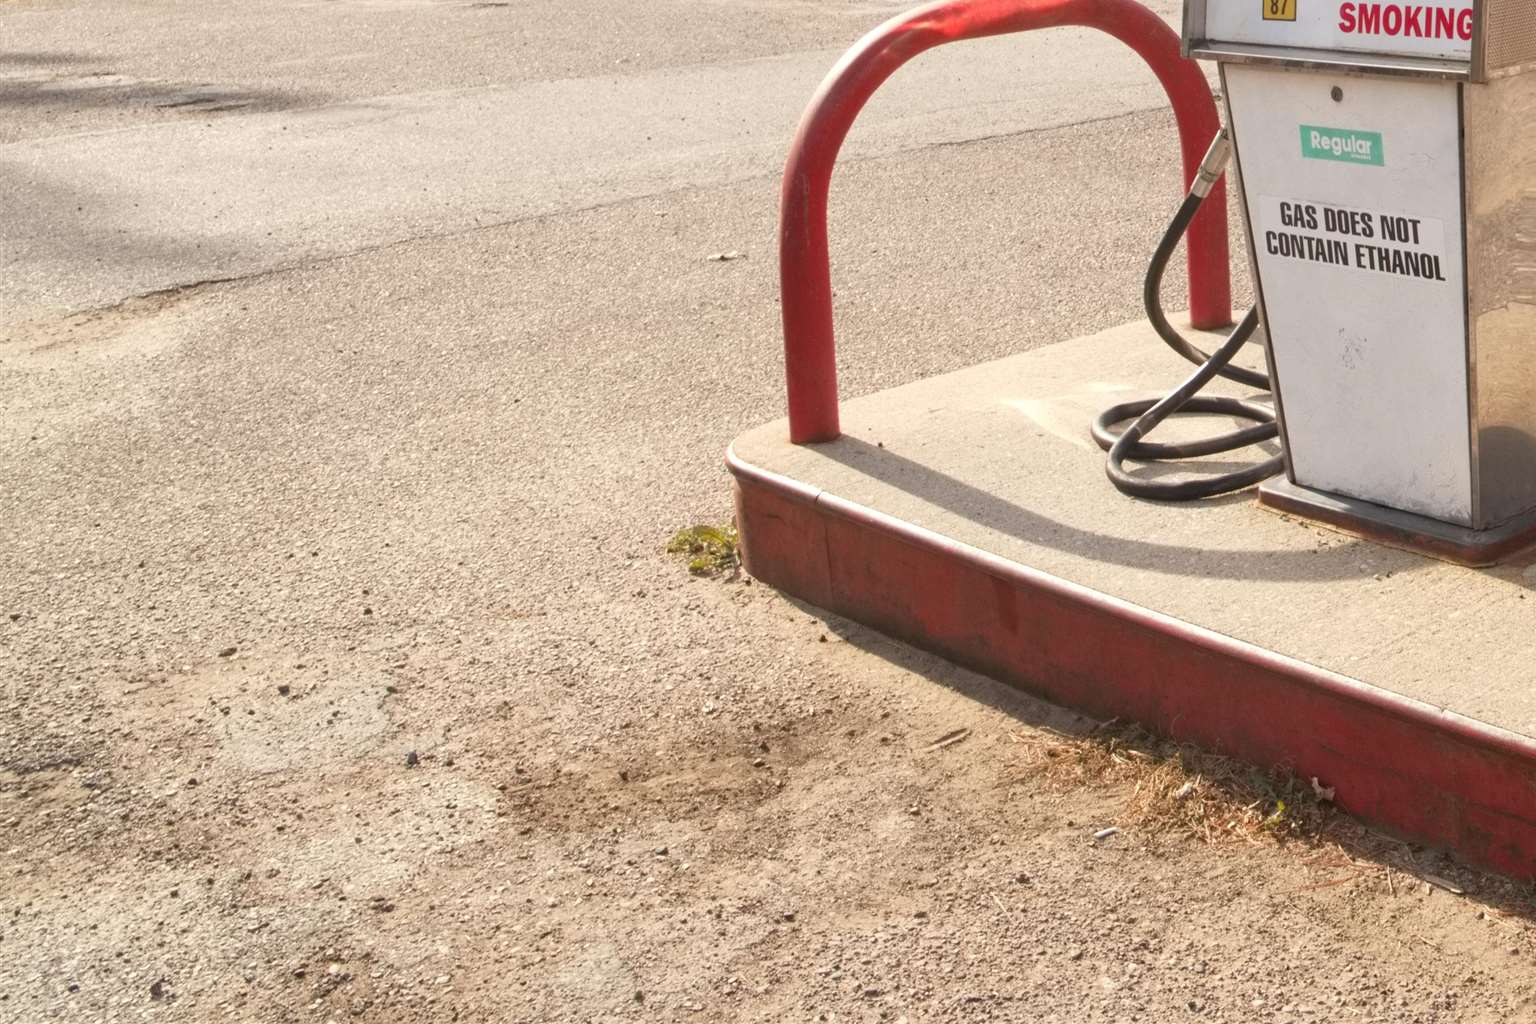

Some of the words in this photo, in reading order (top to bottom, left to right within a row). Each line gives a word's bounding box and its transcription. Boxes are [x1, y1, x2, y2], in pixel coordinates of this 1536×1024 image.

[1338, 2, 1473, 41] SMOKING
[1310, 130, 1372, 156] Regular
[1279, 201, 1318, 230] GAS
[1323, 207, 1374, 238] DOES
[1380, 214, 1420, 245] NOT
[1265, 230, 1349, 266] CONTAIN
[1355, 244, 1446, 282] ETHANOL
